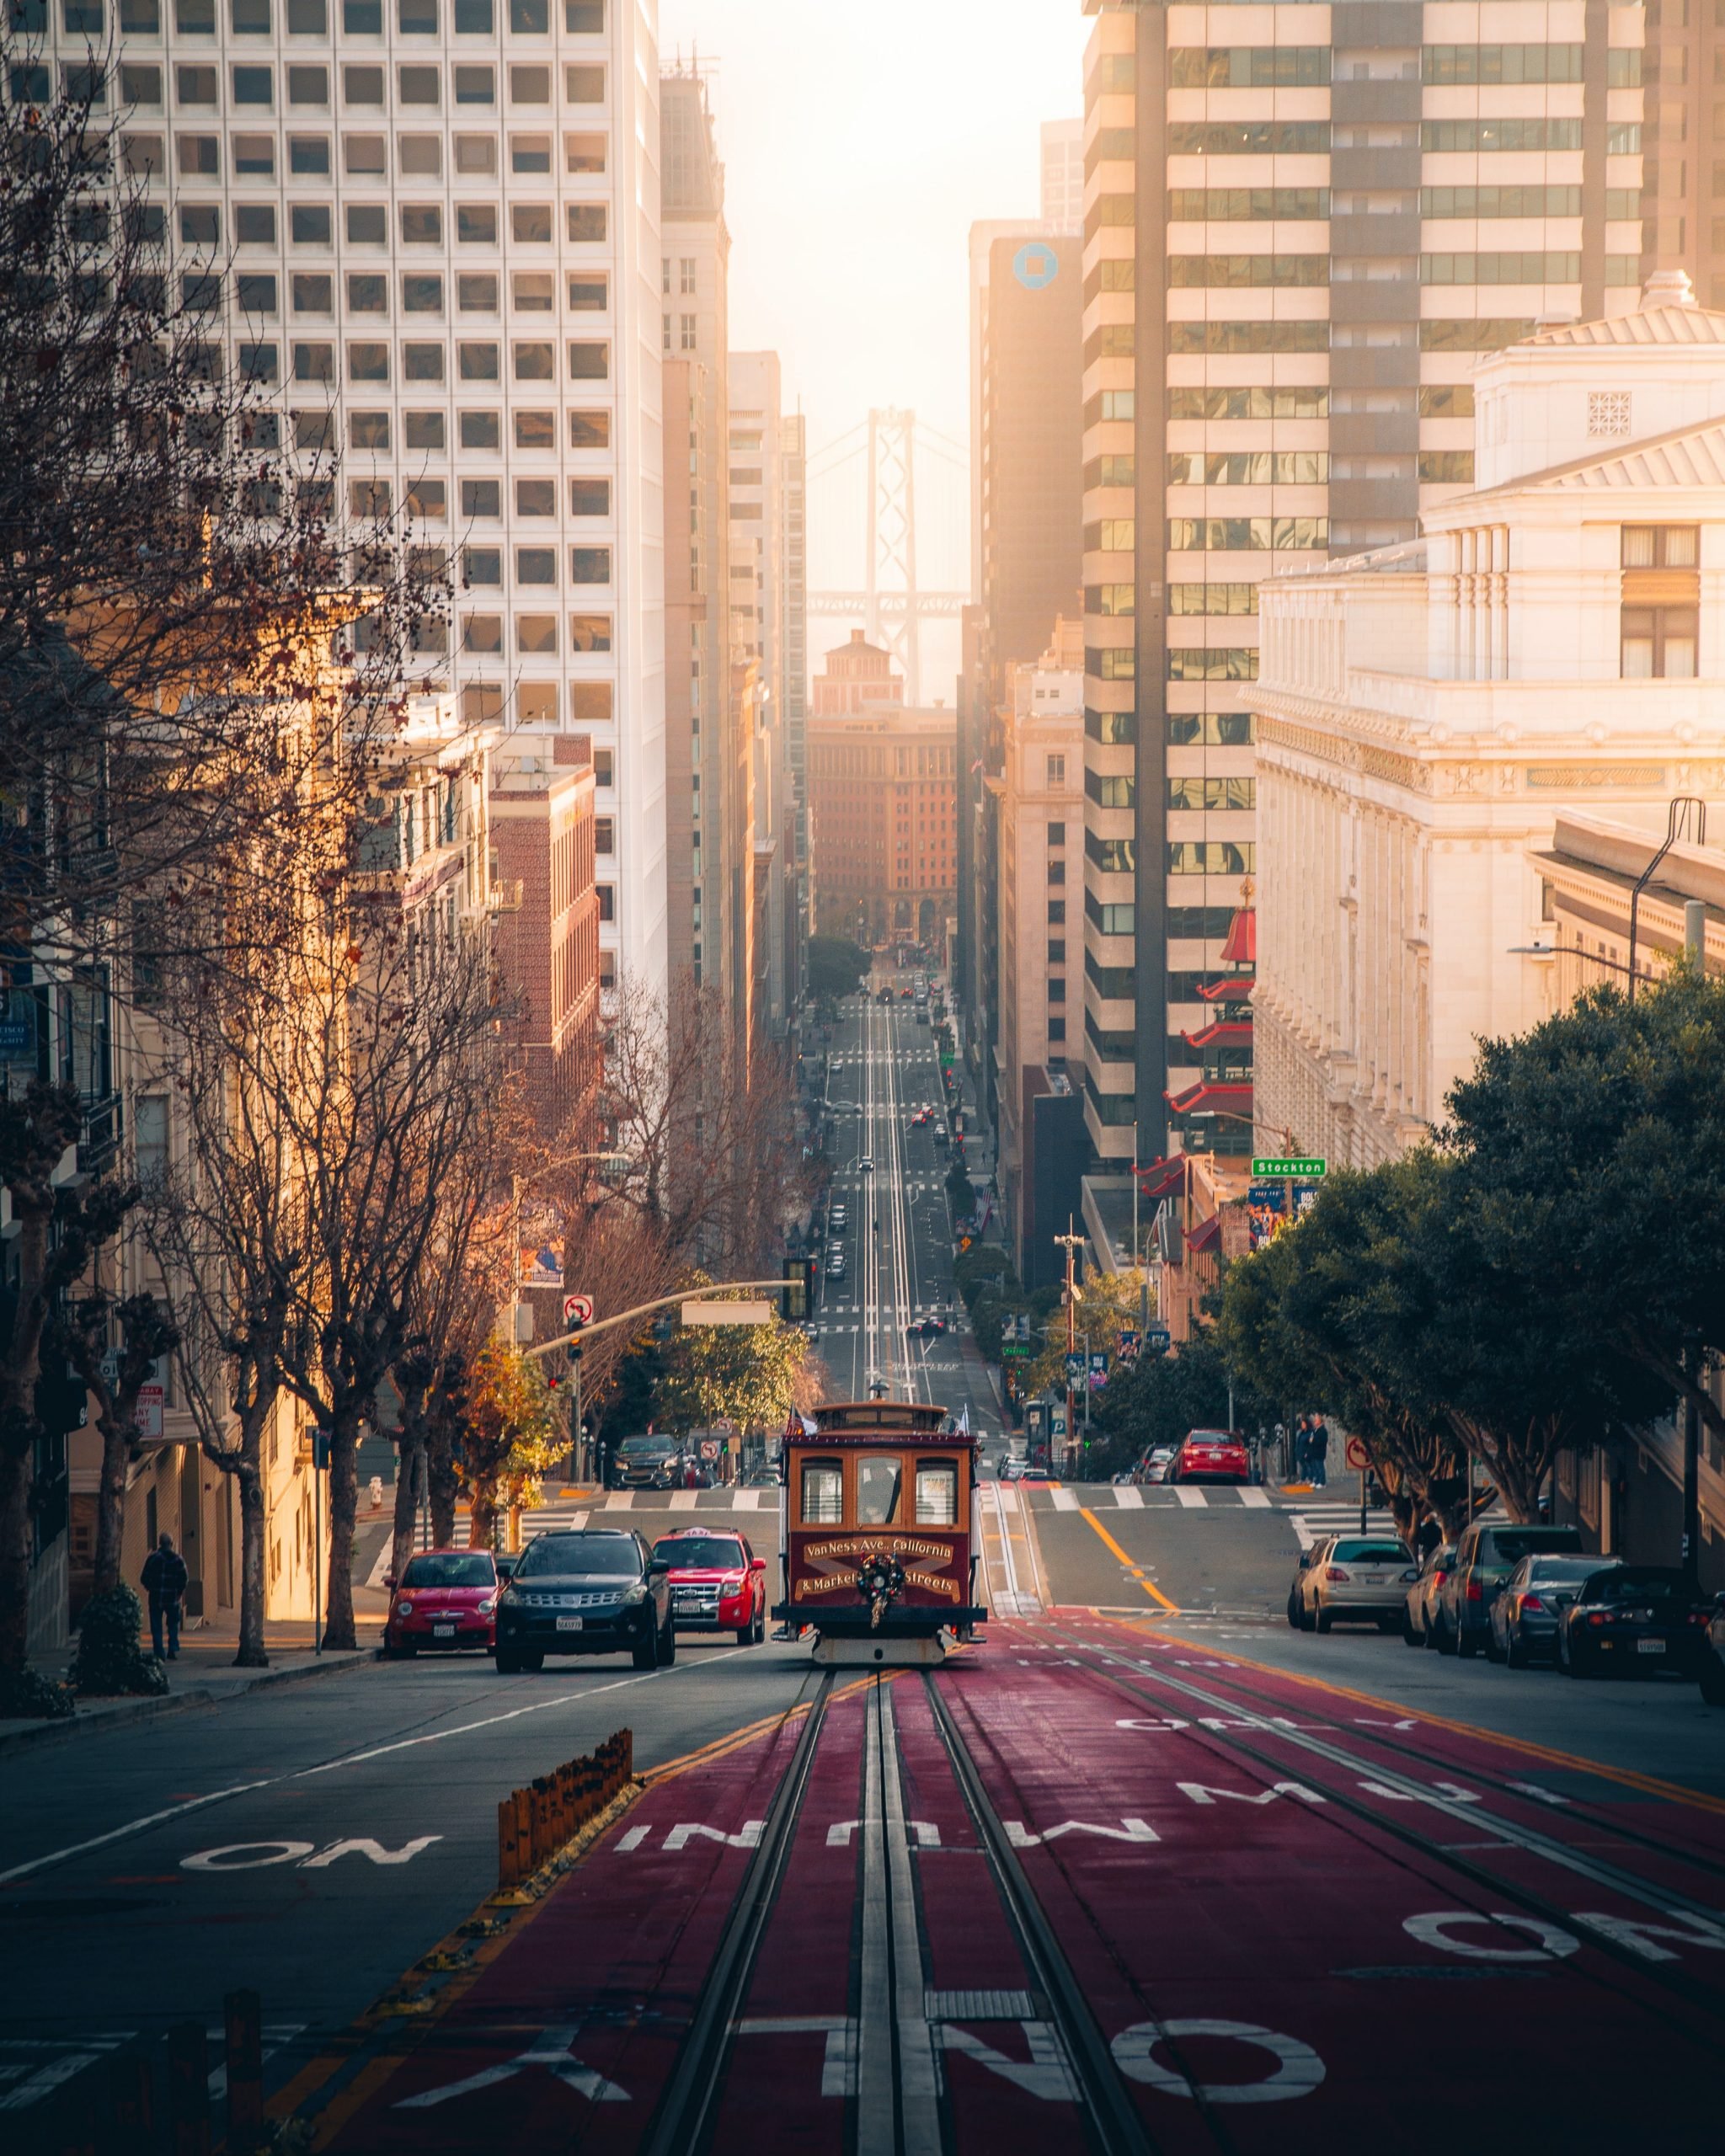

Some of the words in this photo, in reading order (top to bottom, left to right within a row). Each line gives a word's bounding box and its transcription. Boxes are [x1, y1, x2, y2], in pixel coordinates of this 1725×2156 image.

[1258, 1162, 1321, 1172] Stockton
[136, 1418, 151, 1427] IME
[1054, 1421, 1064, 1433] P
[686, 1529, 708, 1537] TAXI
[807, 1545, 827, 1557] Van
[829, 1541, 857, 1553] Ness
[893, 1539, 951, 1557] California
[803, 1580, 811, 1590] &
[814, 1572, 857, 1590] Market
[905, 1572, 953, 1591] Streets
[1116, 1716, 1418, 1732] ONLY
[1175, 1781, 1571, 1804] MUNI
[1402, 1911, 1725, 1961] ON
